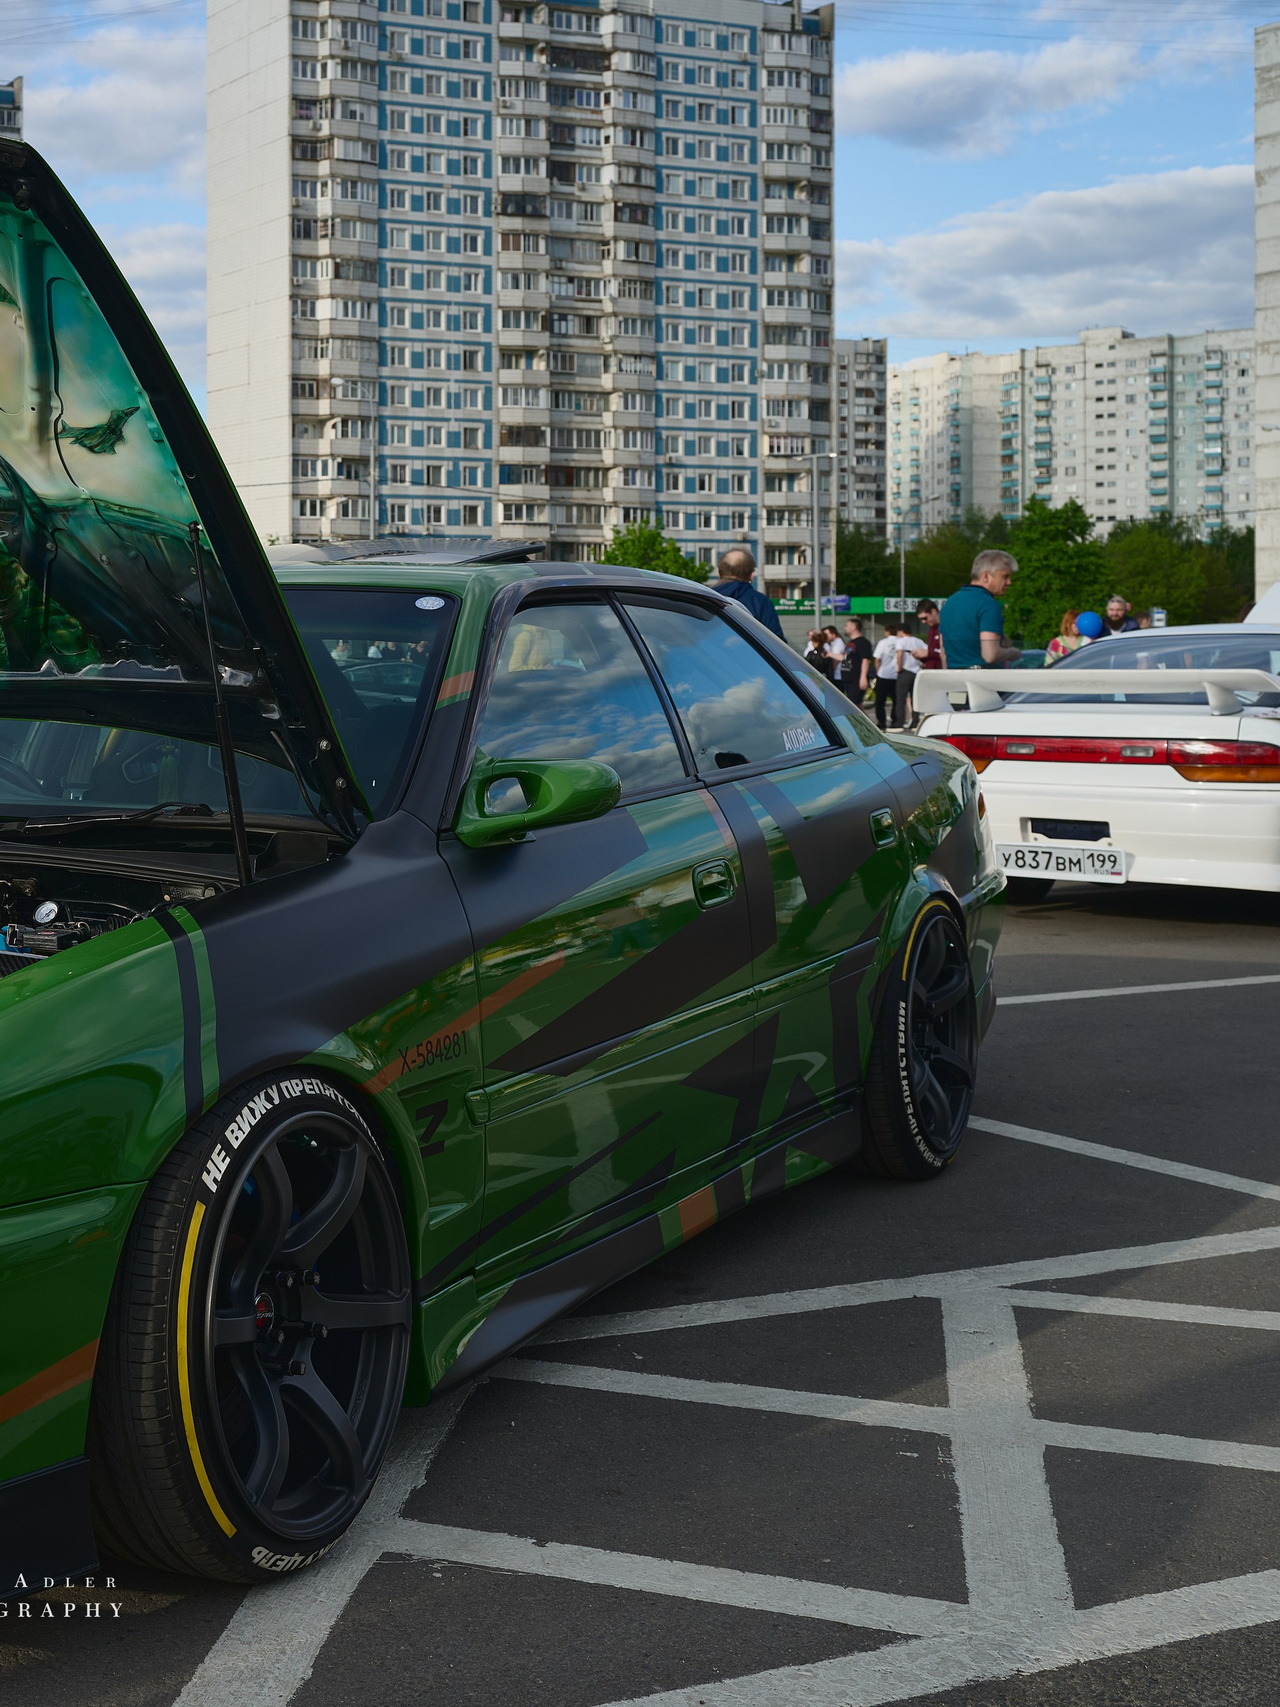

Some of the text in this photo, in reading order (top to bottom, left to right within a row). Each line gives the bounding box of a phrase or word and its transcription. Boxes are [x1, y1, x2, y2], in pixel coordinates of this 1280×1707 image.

[1086, 853, 1117, 869] 199
[398, 1030, 468, 1075] X-584281
[201, 1143, 231, 1193] НЕ
[224, 1084, 280, 1150] ВИЖУ
[251, 1546, 304, 1572] ЦЕЛЬ
